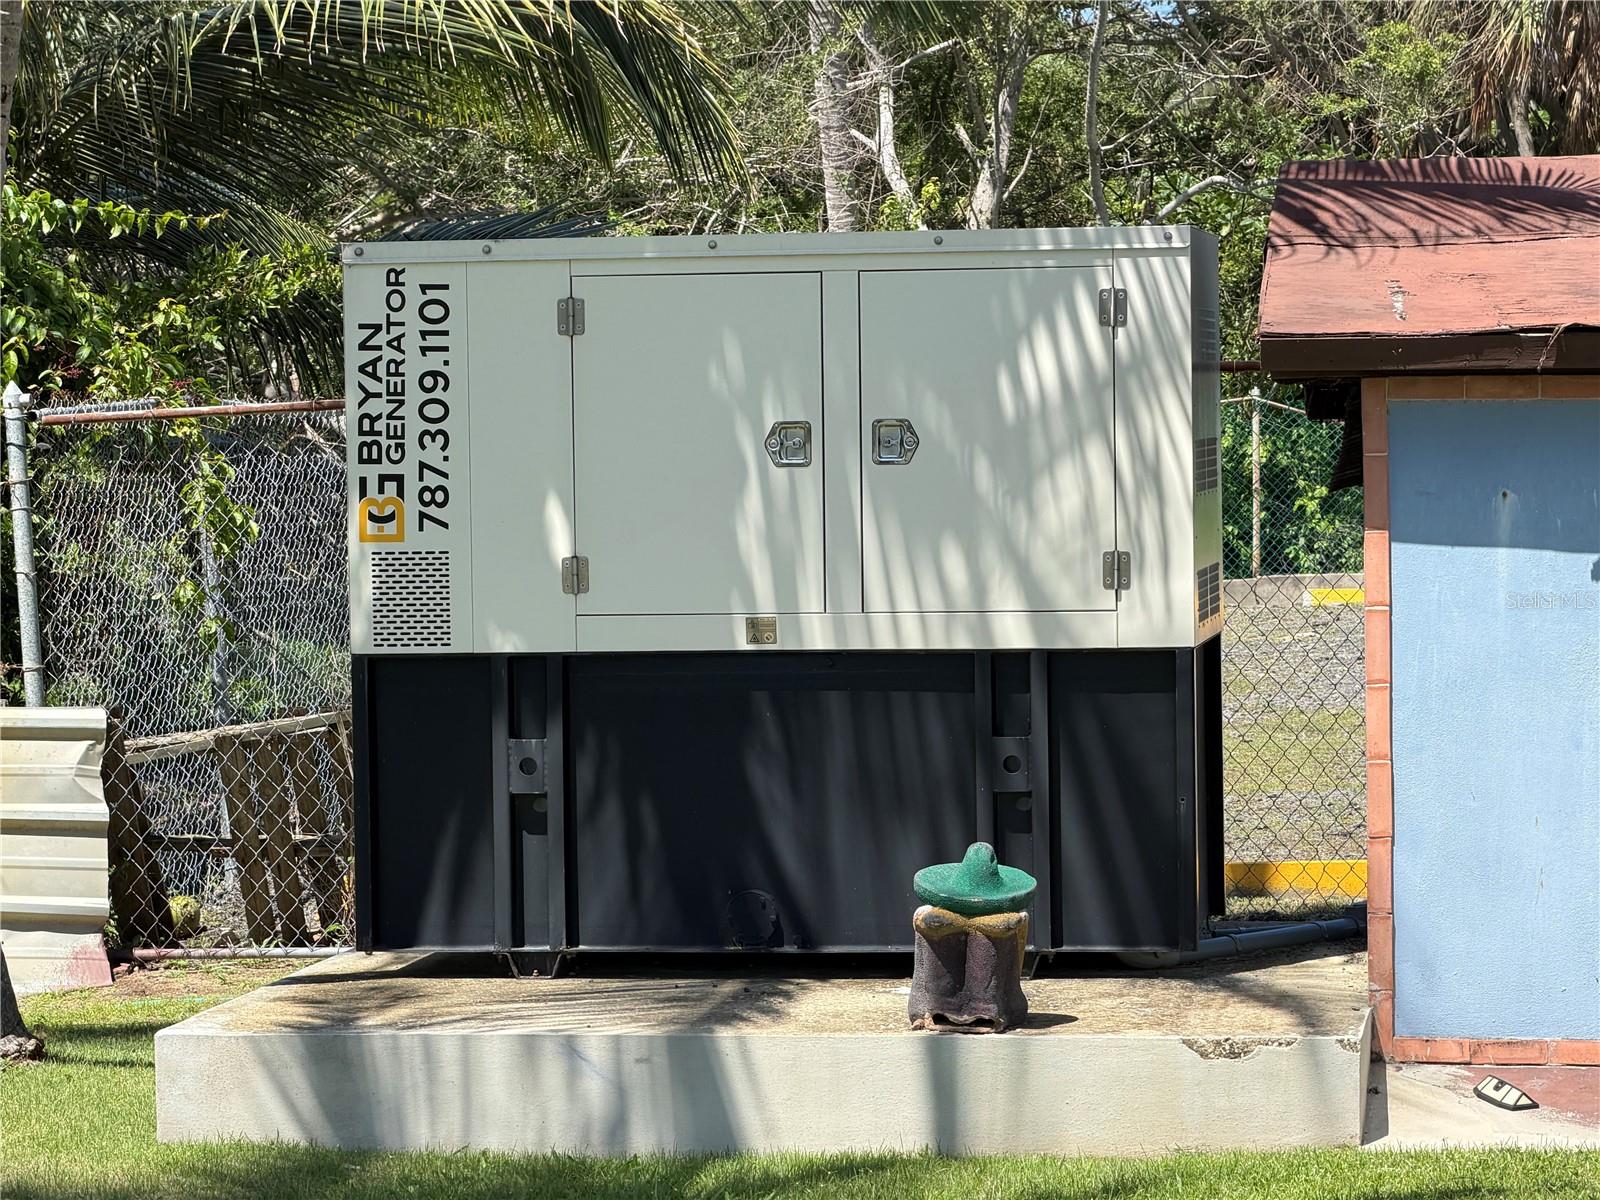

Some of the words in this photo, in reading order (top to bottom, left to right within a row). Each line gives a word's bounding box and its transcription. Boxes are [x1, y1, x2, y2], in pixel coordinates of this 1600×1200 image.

[358, 323, 383, 465] BRYAN
[385, 267, 406, 465] GENERATOR
[418, 283, 450, 532] 787.309.1101
